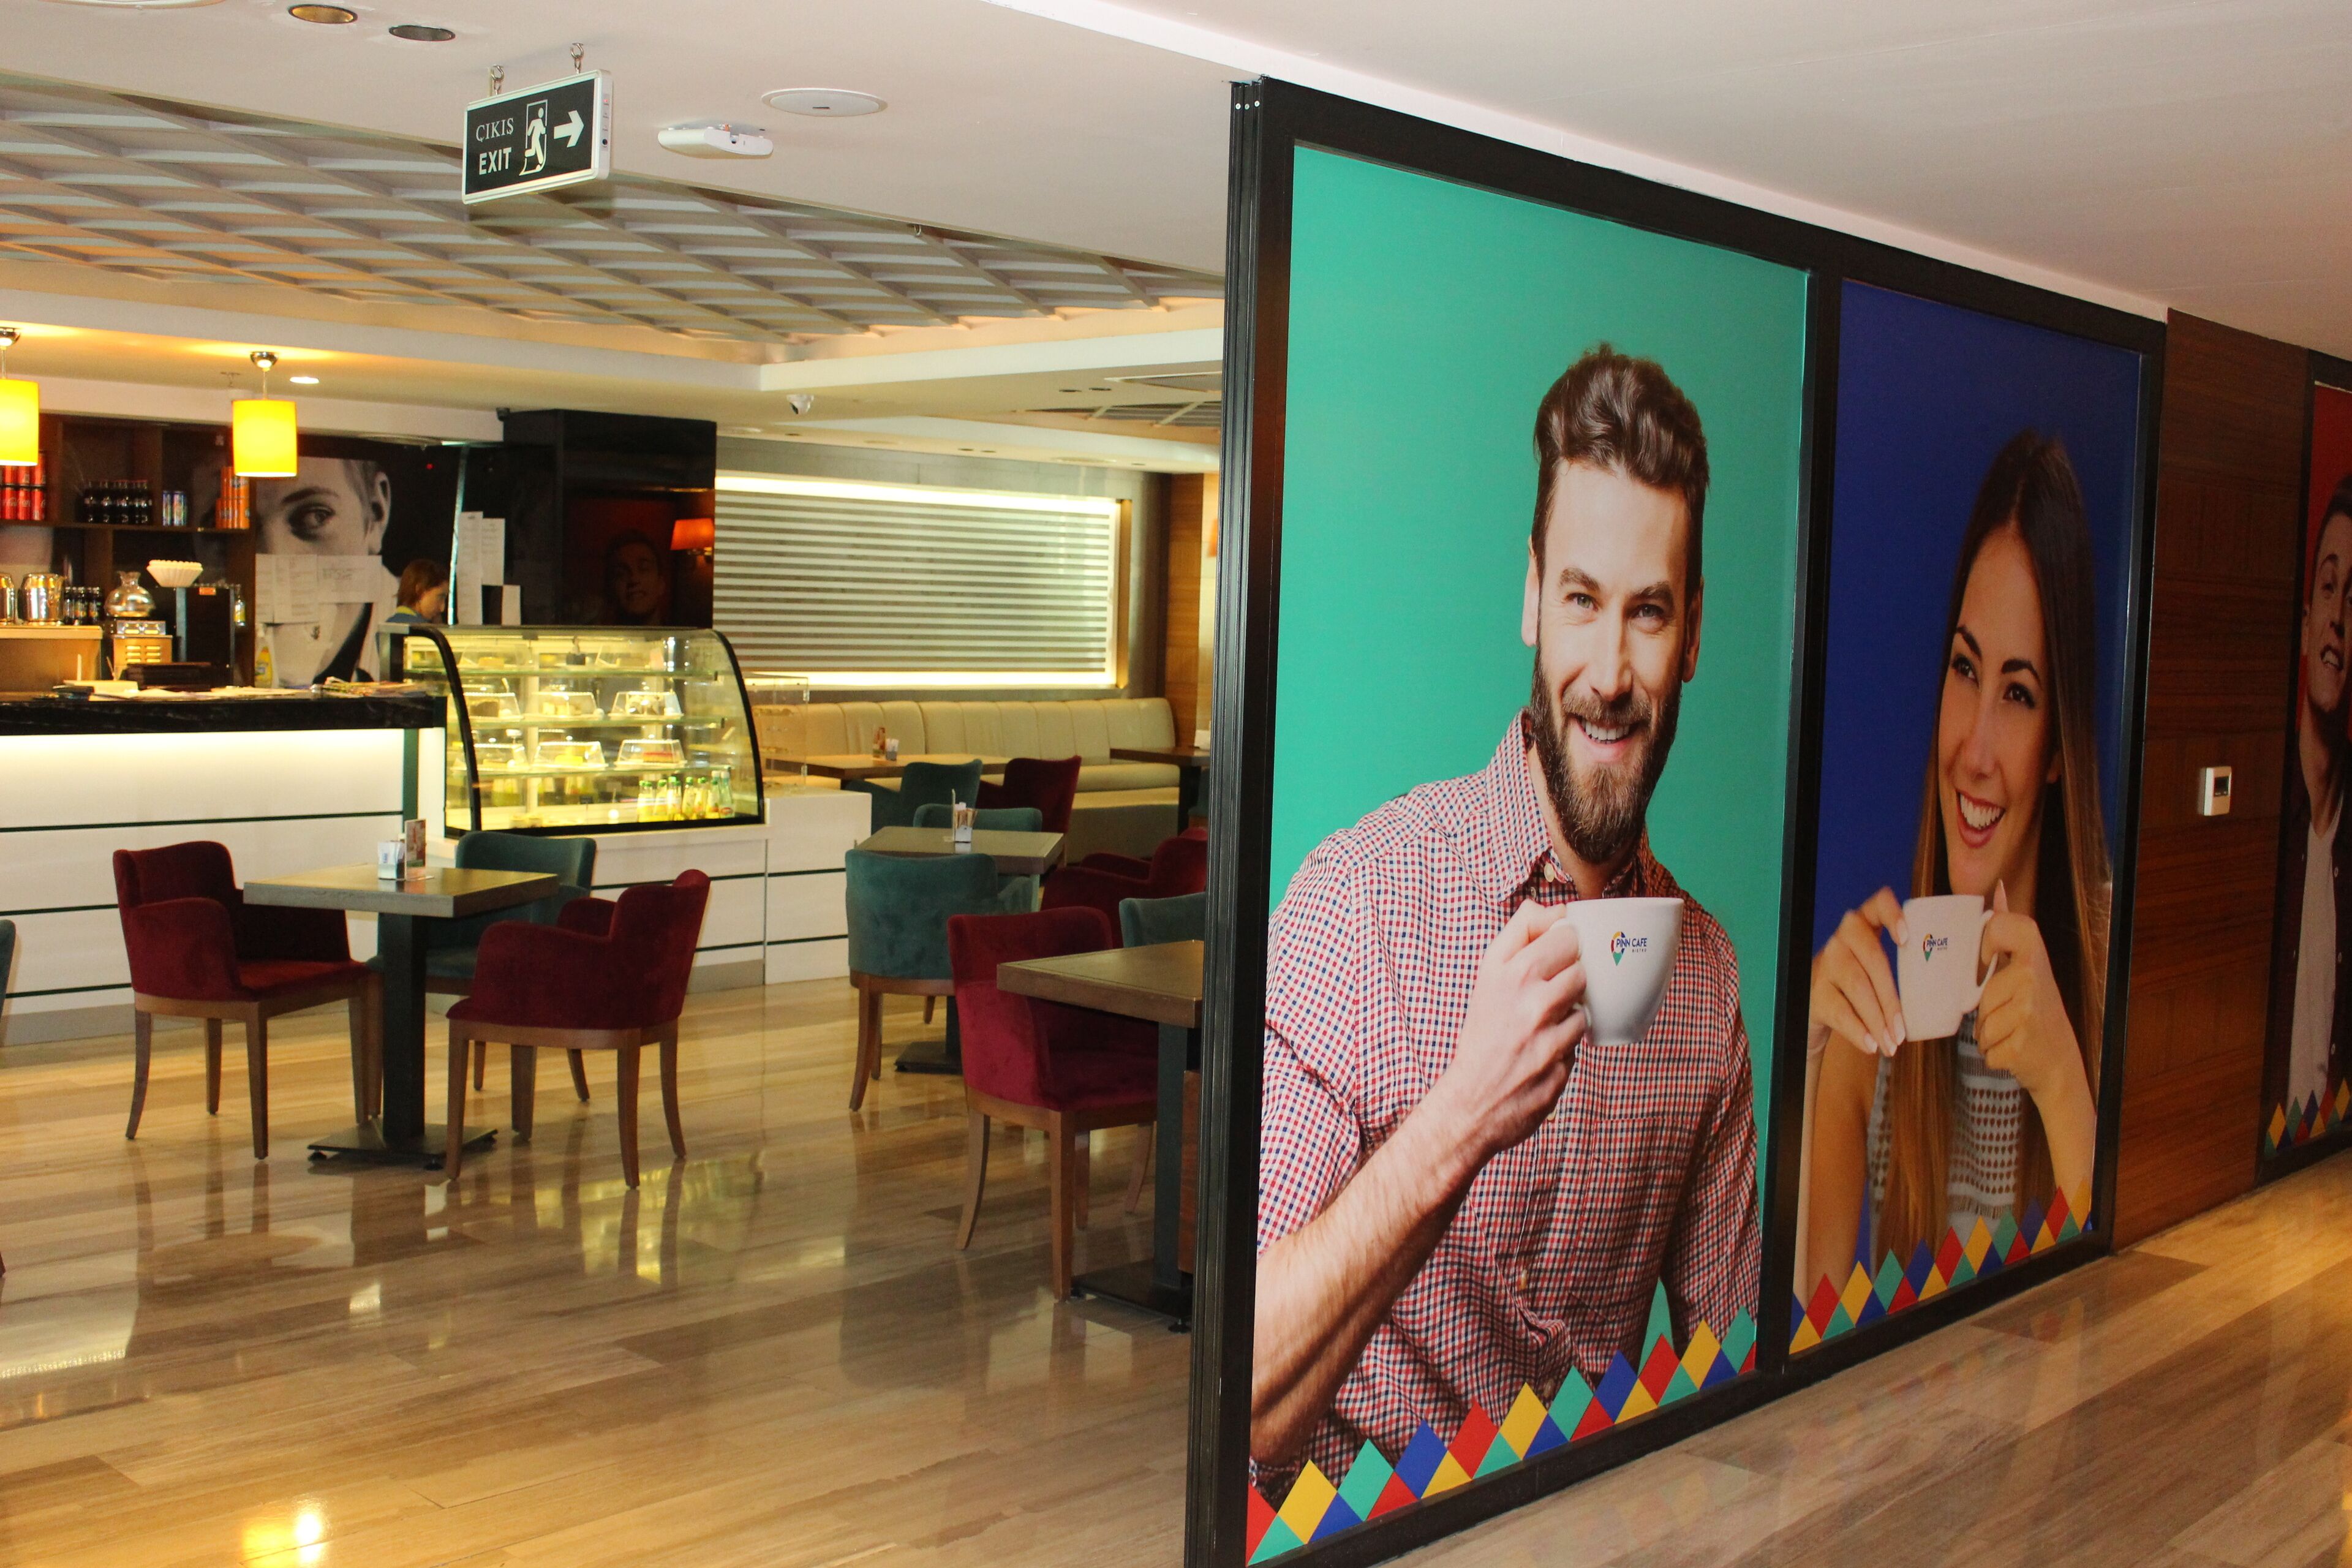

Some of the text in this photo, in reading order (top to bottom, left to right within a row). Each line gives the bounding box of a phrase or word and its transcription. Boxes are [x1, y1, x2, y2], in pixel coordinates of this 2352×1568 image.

[479, 146, 512, 175] EXIT
[1616, 937, 1648, 948] PINN CAFE
